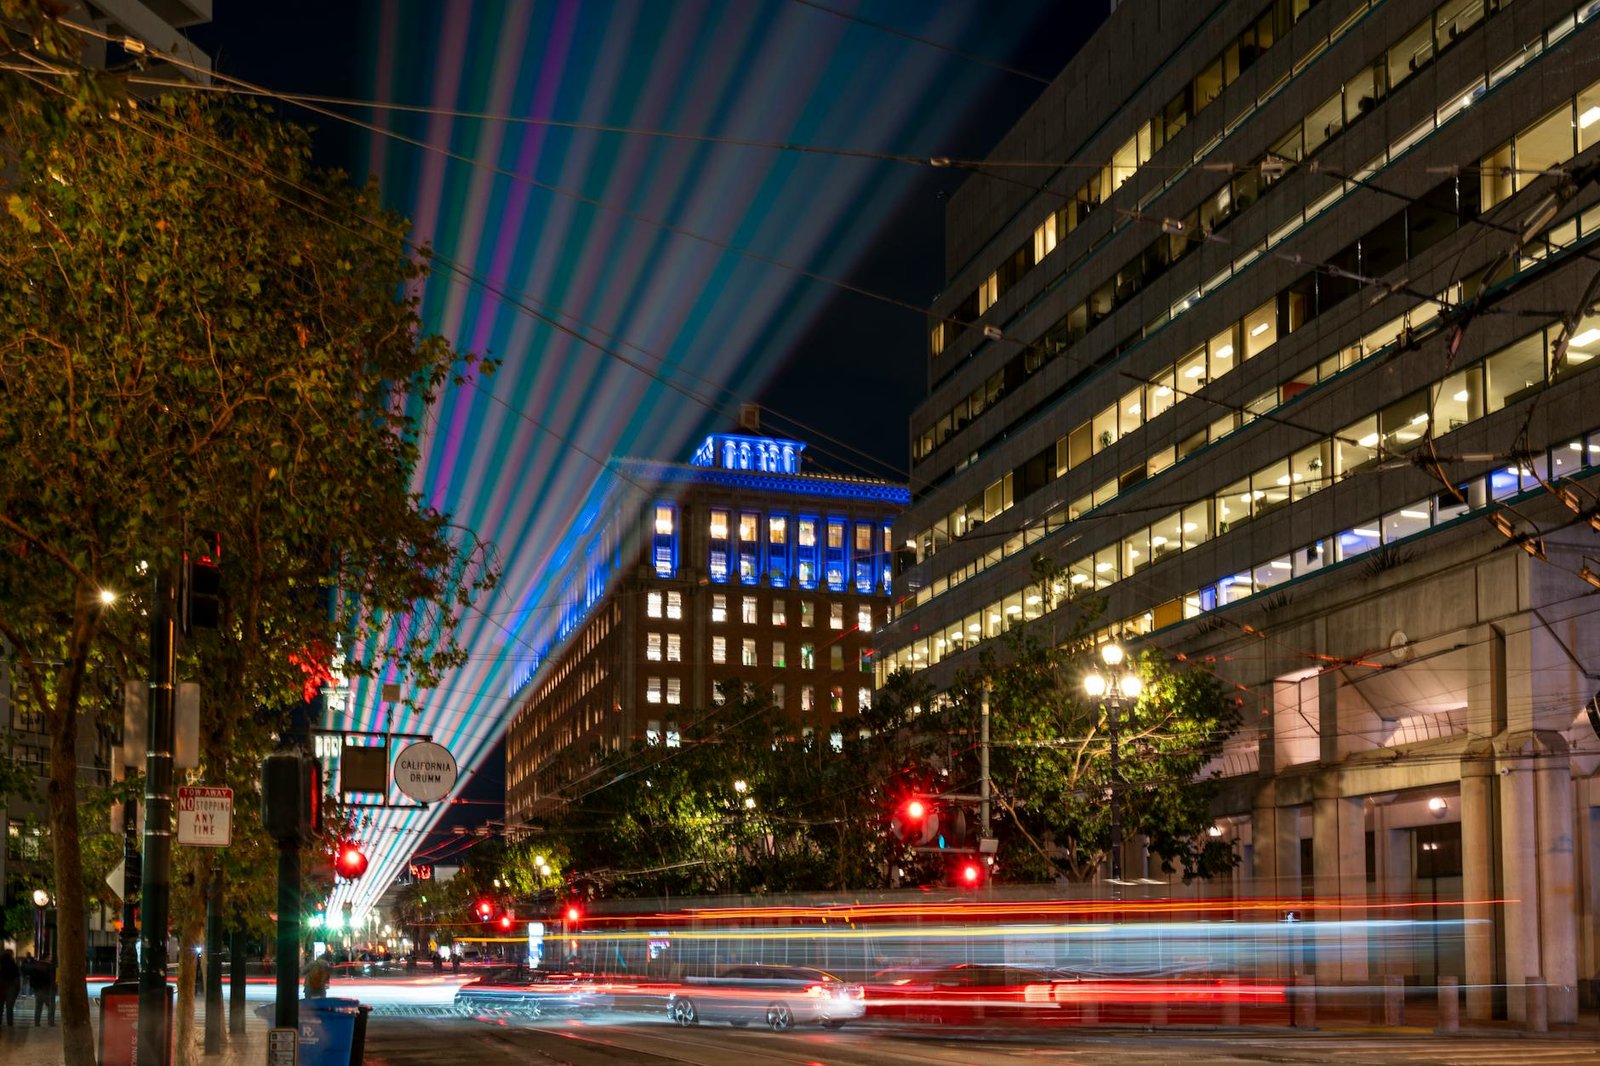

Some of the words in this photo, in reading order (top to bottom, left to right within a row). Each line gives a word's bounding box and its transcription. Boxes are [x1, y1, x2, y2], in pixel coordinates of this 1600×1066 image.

[401, 760, 451, 772] CALIFORNIA
[410, 773, 441, 783] DRUMM
[180, 797, 194, 810] NO
[196, 800, 230, 812] STOPPING
[194, 814, 215, 824] ANY
[193, 824, 215, 835] TIME
